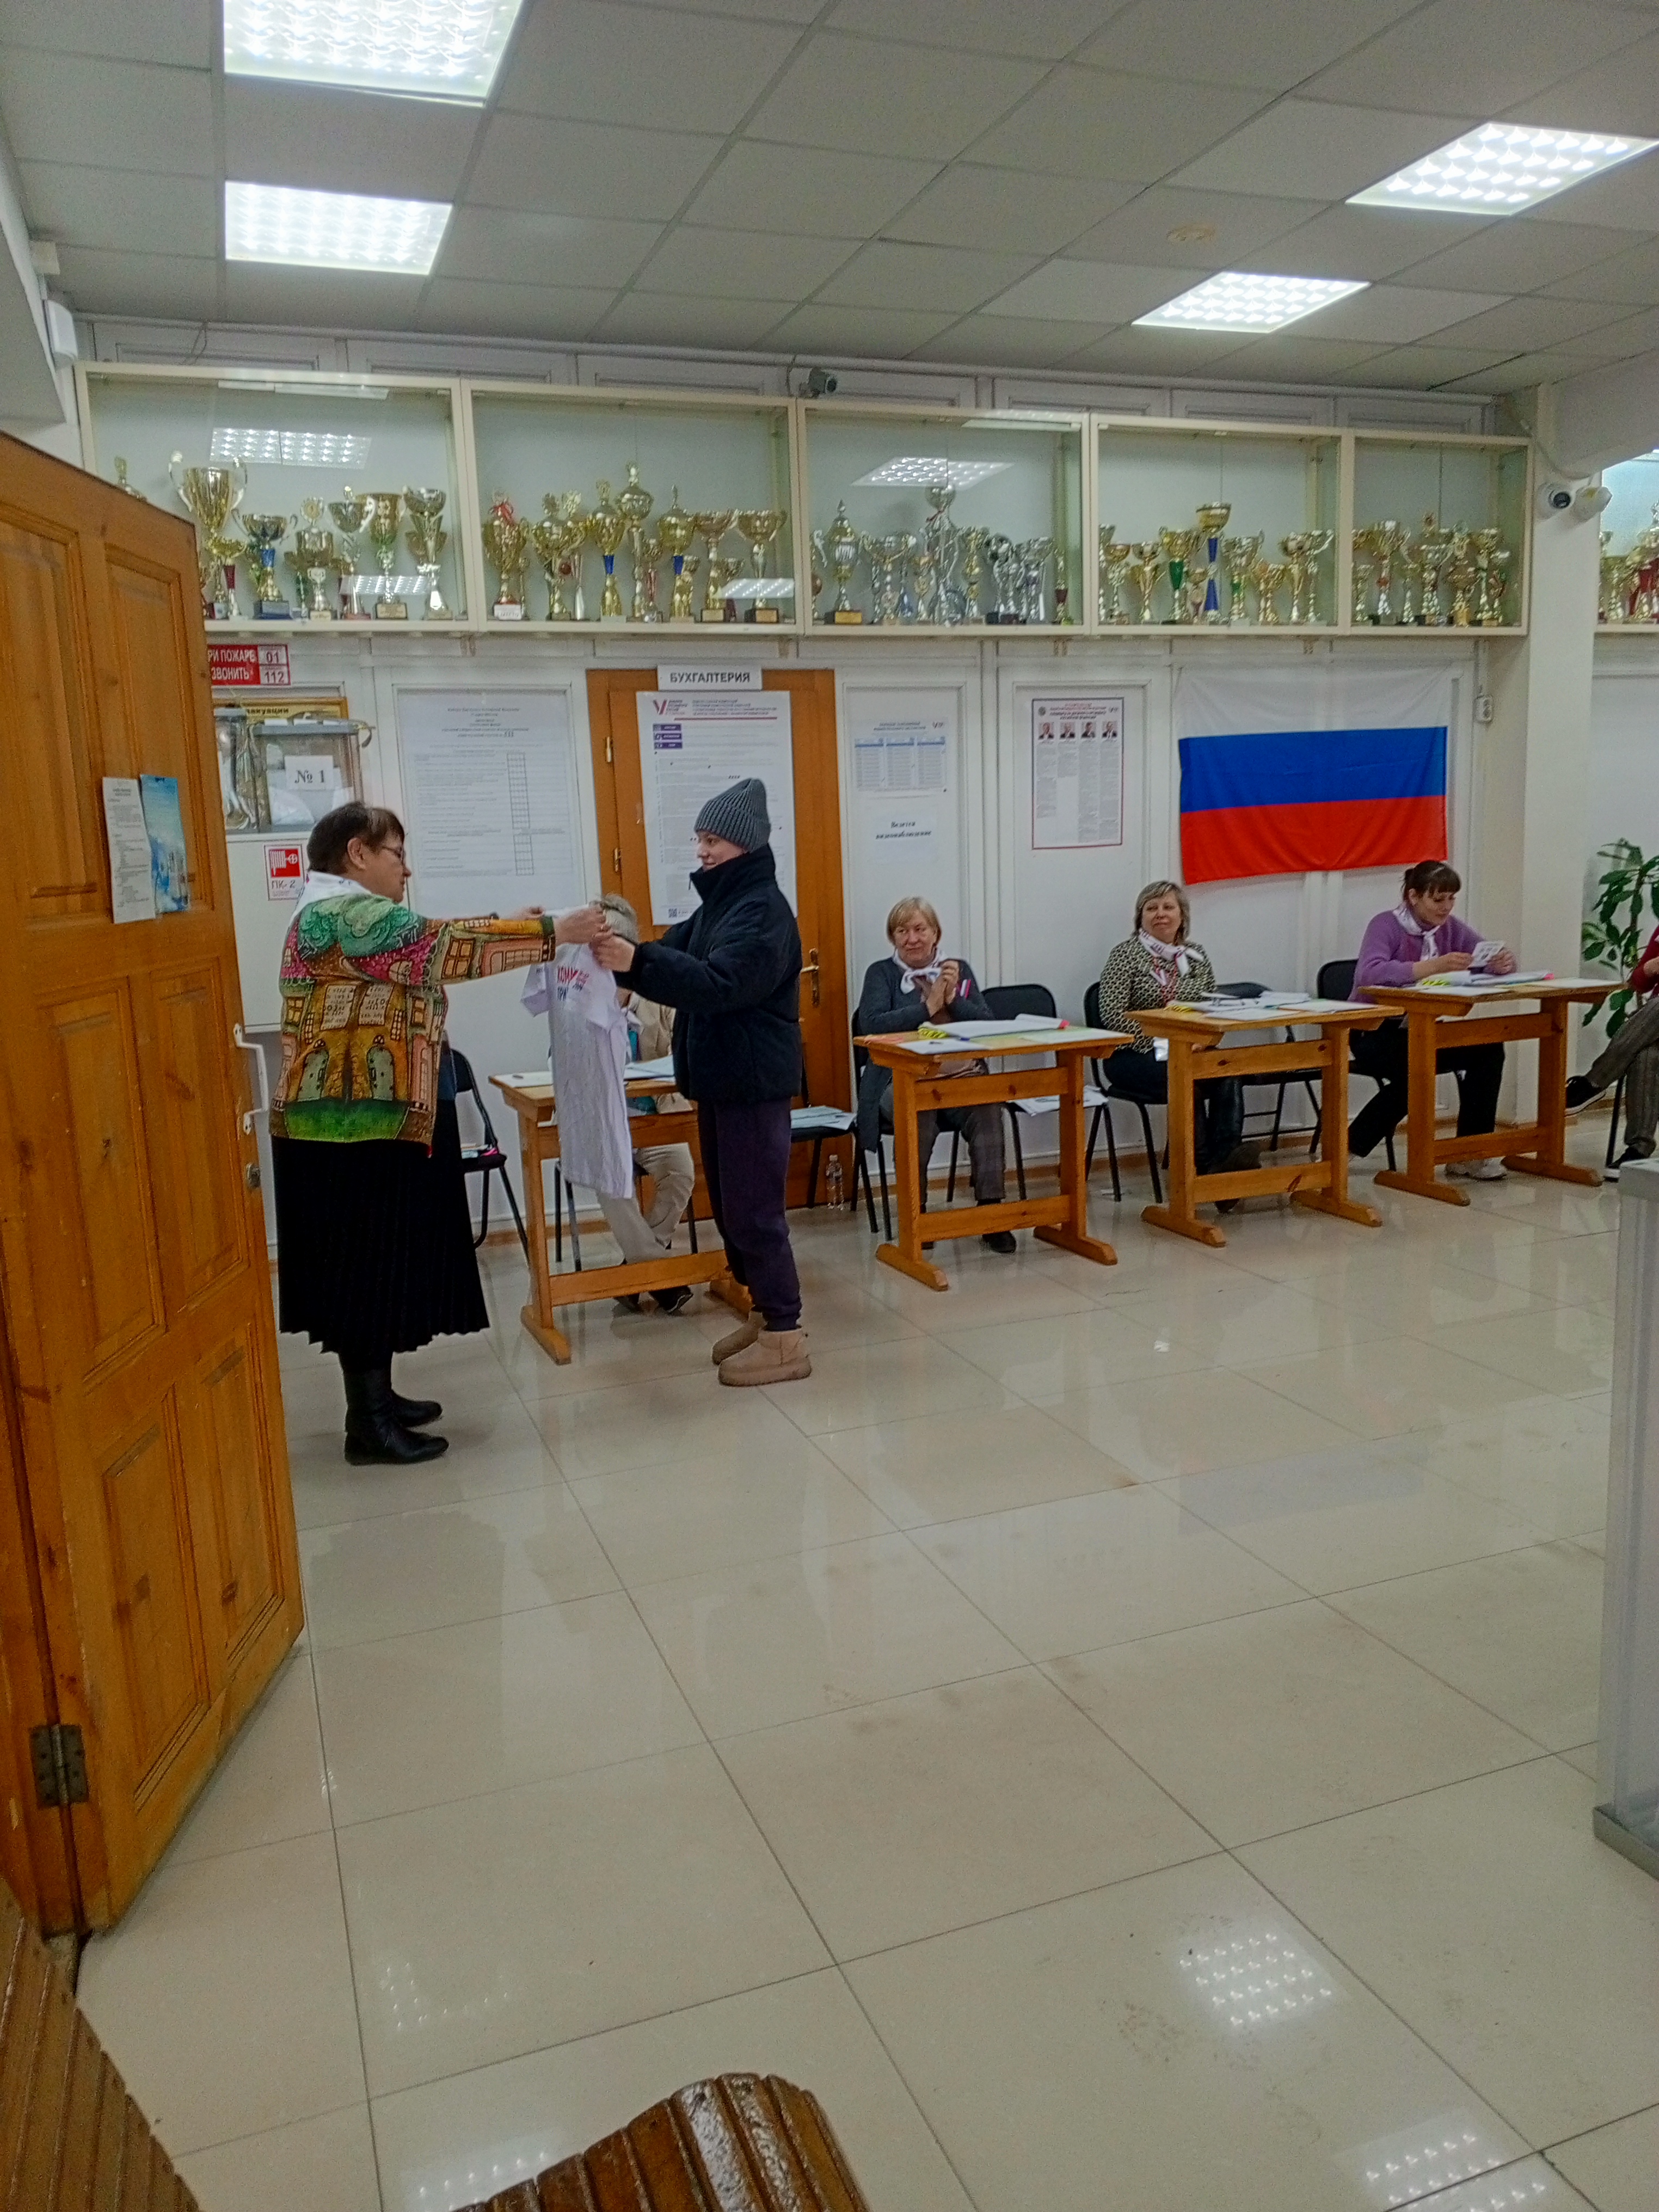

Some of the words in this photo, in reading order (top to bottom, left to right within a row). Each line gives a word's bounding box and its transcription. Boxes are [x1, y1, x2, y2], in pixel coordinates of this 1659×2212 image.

[207, 649, 219, 662] РИ
[220, 649, 255, 662] ПОЖАРЕ
[266, 652, 279, 663] 01
[211, 667, 250, 680] ЗВОНИТЬ
[265, 671, 284, 683] 112
[670, 672, 751, 684] БУХГАЛТЕРИЯ
[294, 769, 313, 783] №
[319, 770, 325, 783] 1
